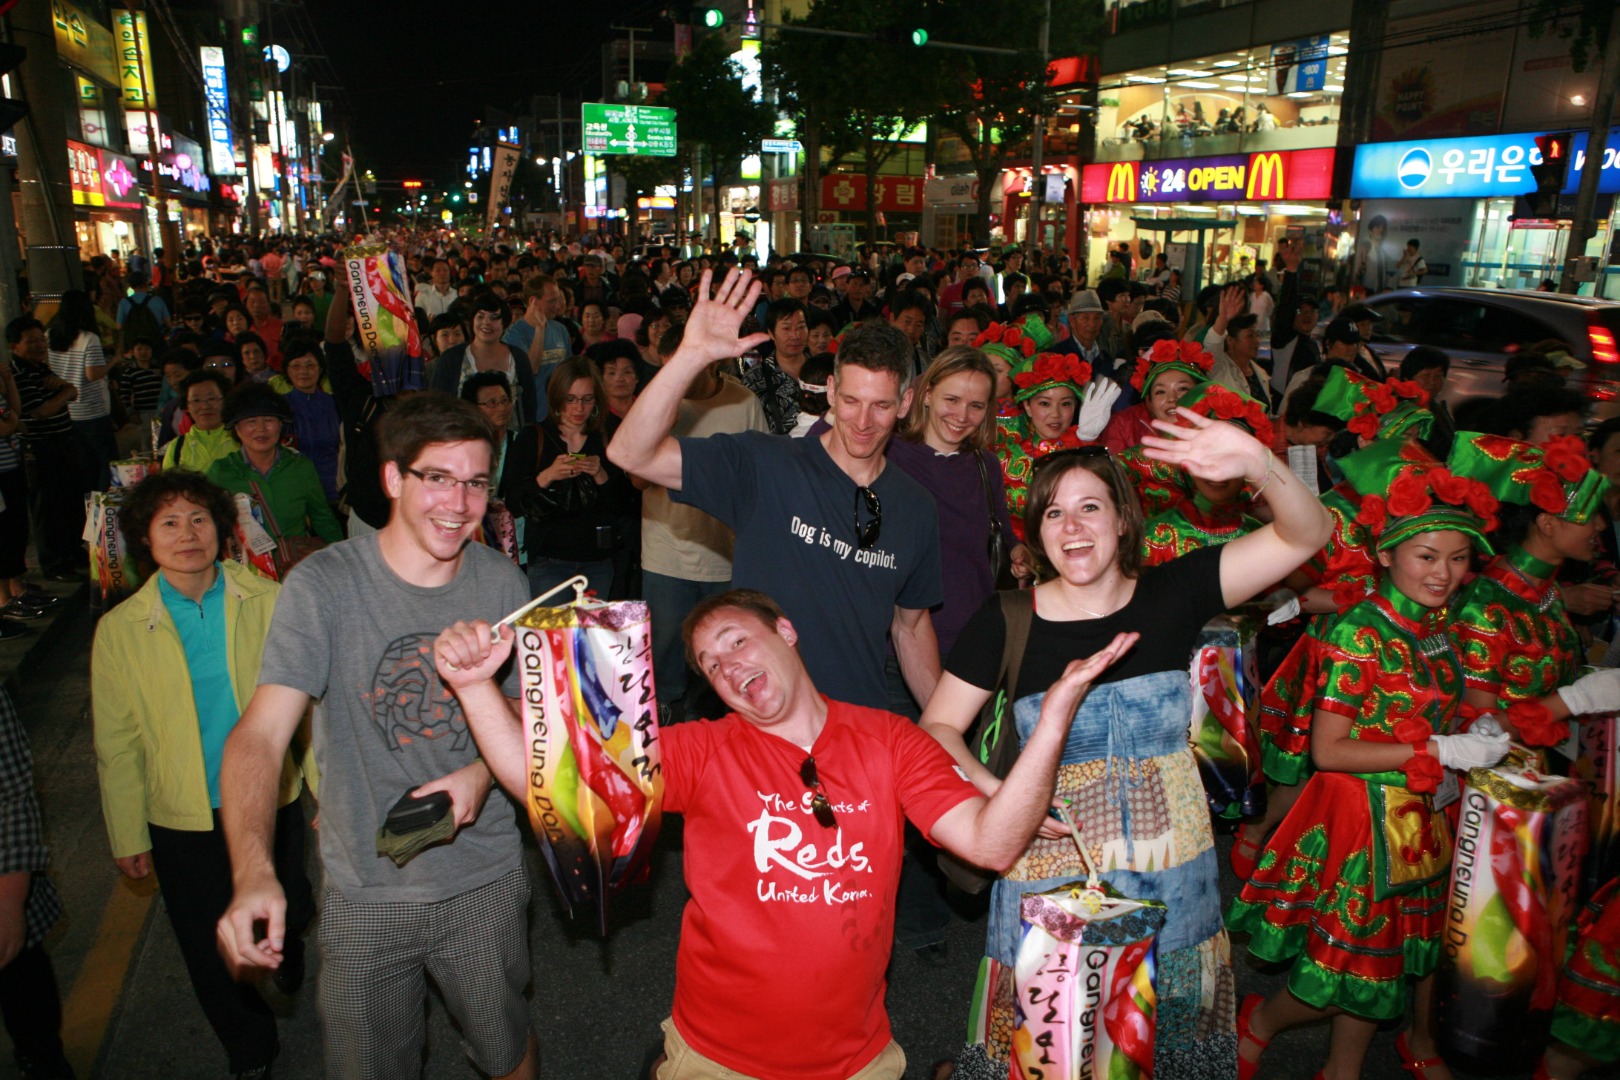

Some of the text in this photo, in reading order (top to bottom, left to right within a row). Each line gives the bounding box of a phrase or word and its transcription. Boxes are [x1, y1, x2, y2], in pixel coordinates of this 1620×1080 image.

[1161, 168, 1184, 193] 24
[1188, 165, 1246, 191] OPEN
[348, 260, 372, 330] Gangneung
[104, 507, 120, 570] Gangneung
[791, 516, 897, 570] Dog is my copilot.
[522, 630, 549, 789] Gangneung
[757, 790, 797, 812] The
[857, 799, 872, 813] of
[747, 808, 873, 880] Reds.
[1449, 791, 1488, 925] Gangneung
[757, 878, 820, 902] United
